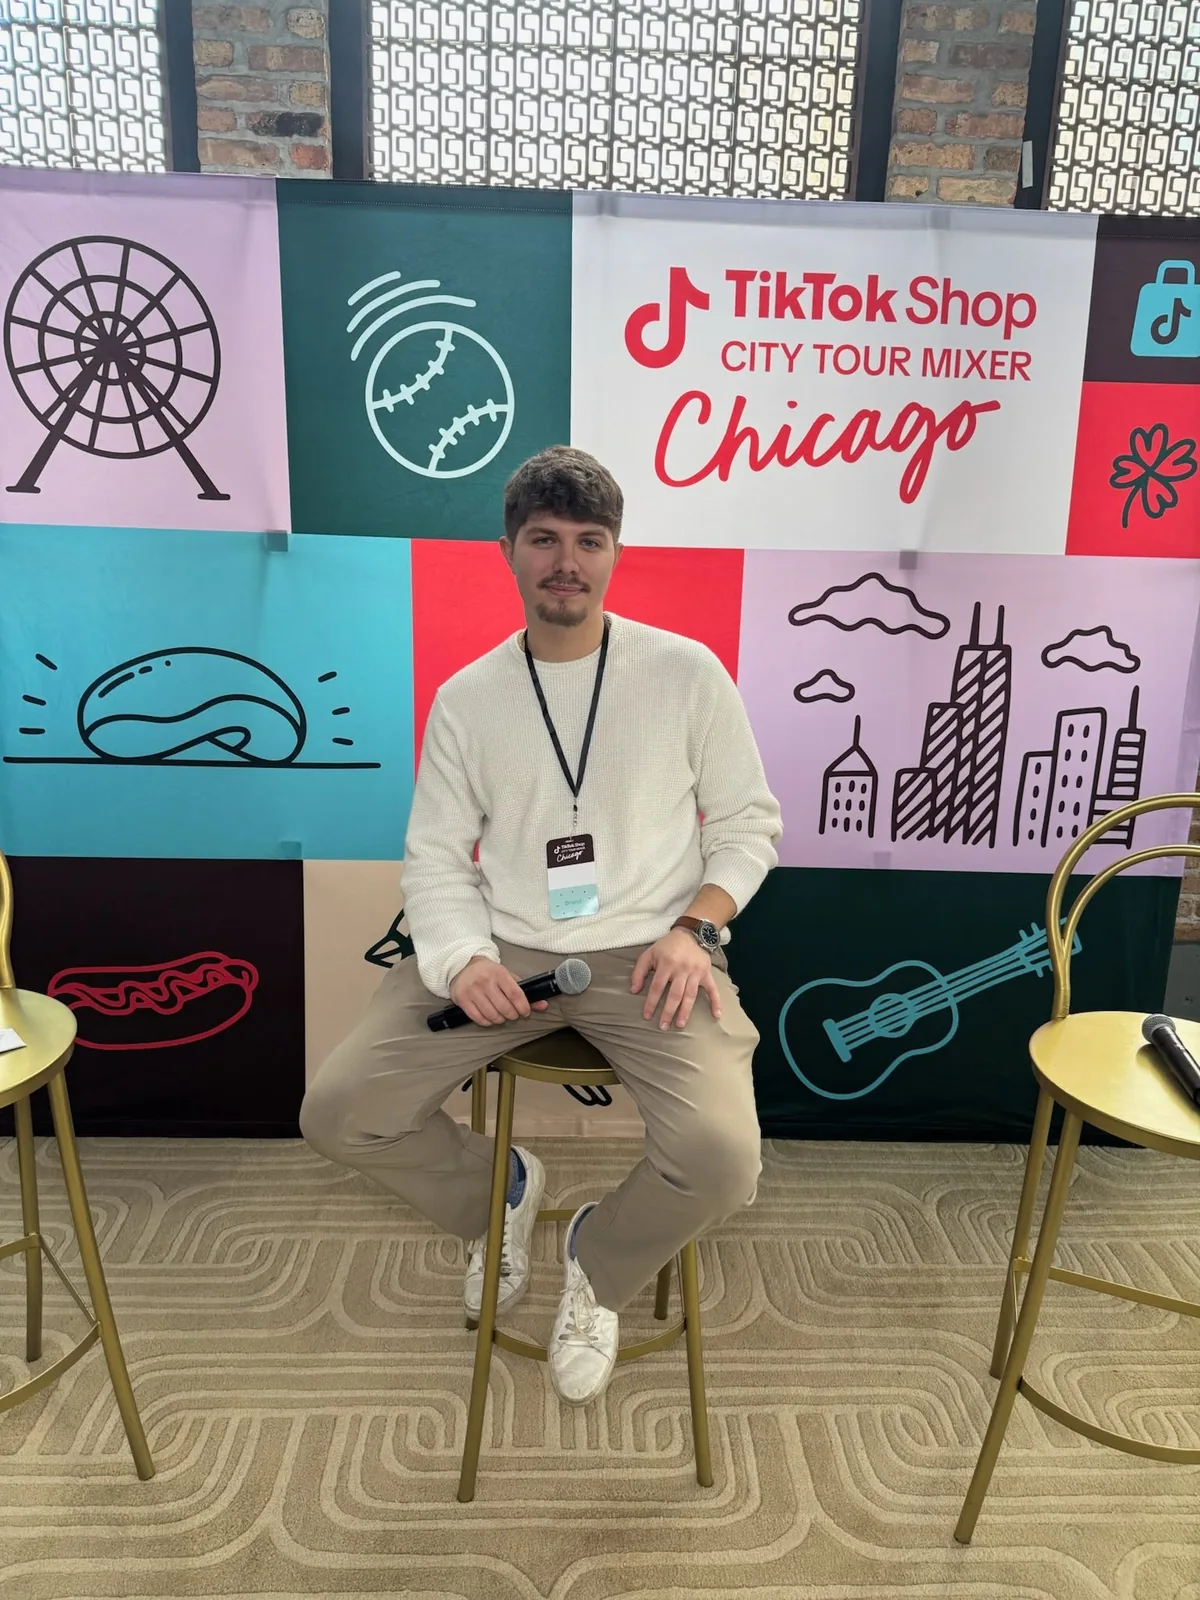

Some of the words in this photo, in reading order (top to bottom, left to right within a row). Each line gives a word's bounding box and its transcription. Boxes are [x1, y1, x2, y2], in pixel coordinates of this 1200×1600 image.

[725, 269, 898, 323] TikTok
[905, 275, 1037, 340] Shop
[720, 341, 804, 373] CITY
[812, 344, 911, 377] TOUR
[921, 348, 1031, 381] MIXER
[654, 390, 1001, 504] Chicago
[556, 850, 583, 862] Chicago
